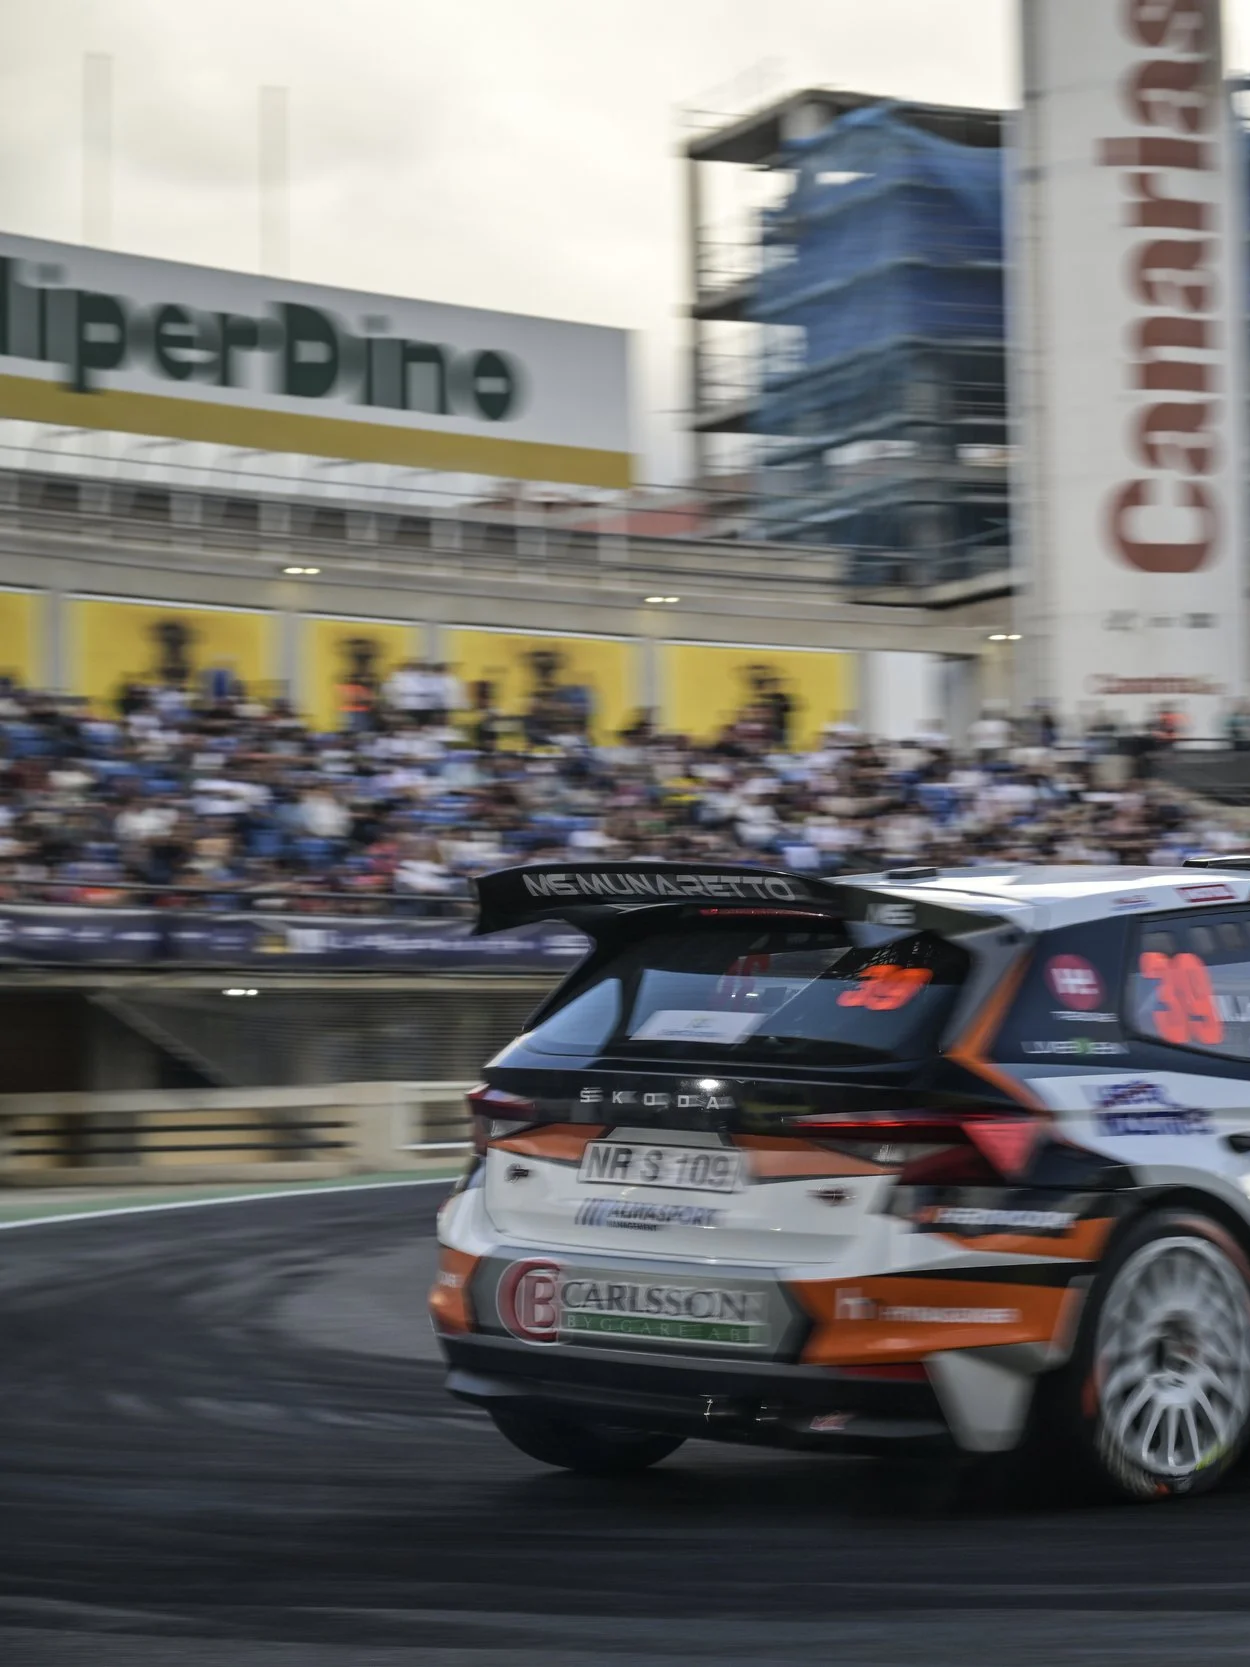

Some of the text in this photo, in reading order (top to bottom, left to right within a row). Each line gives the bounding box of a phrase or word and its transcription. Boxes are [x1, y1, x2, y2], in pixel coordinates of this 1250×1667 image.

[576, 874, 796, 901] MUNARETTO
[1140, 952, 1224, 1044] 39
[561, 1279, 749, 1321] CARLSSON
[566, 1314, 690, 1336] BYGGARE
